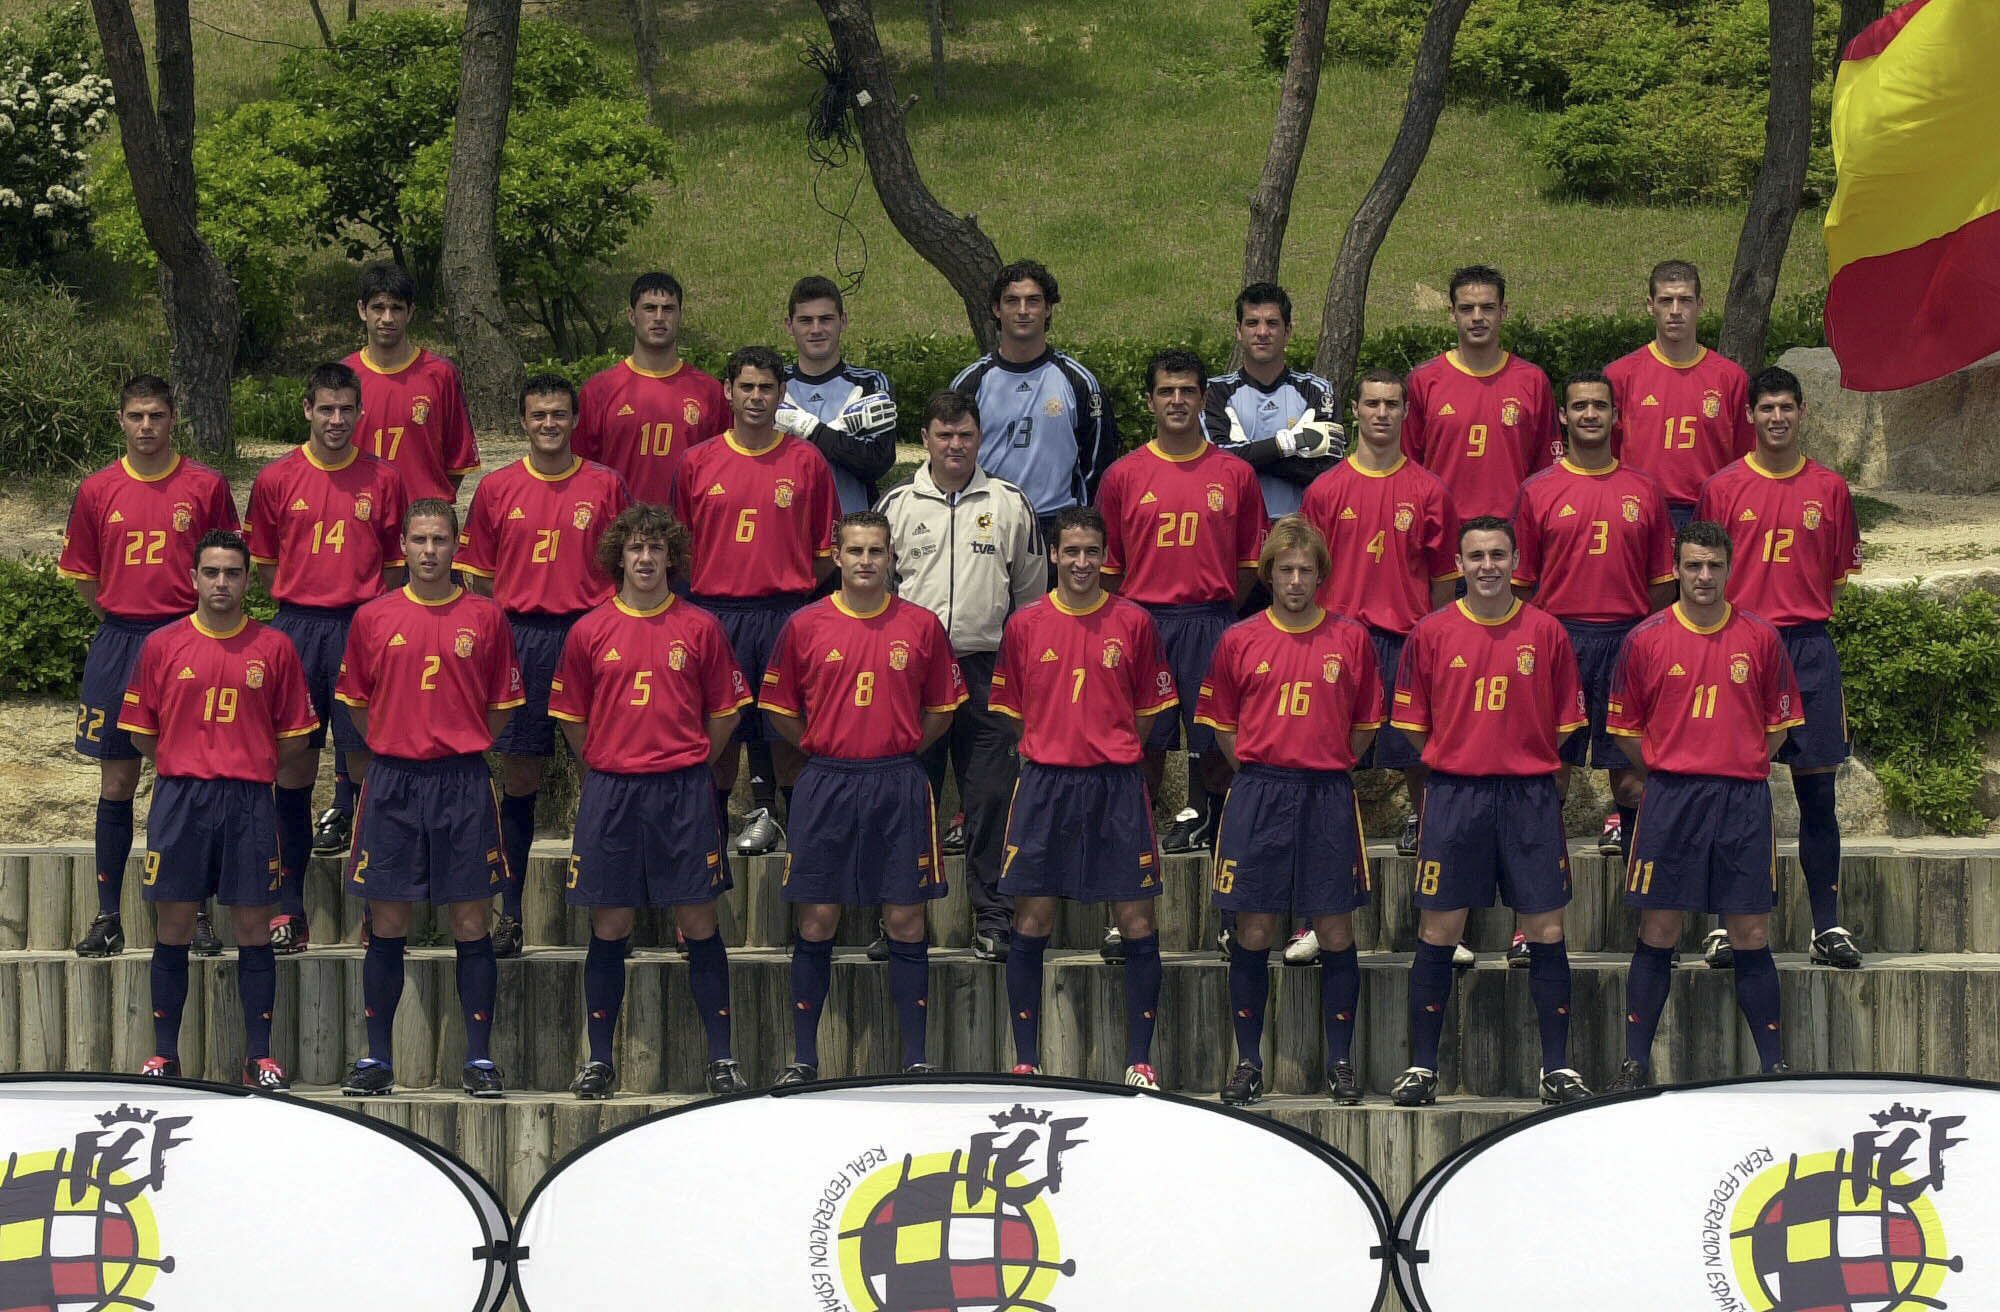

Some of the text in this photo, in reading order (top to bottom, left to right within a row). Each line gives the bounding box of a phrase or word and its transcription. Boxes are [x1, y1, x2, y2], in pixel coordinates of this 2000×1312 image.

[373, 426, 405, 461] 17
[640, 422, 674, 457] 10
[1006, 416, 1033, 449] 13
[1466, 424, 1487, 458] 9
[1664, 415, 1697, 450] 15
[311, 519, 347, 555] 14
[734, 508, 759, 544] 6
[1156, 511, 1200, 549] 20
[1589, 520, 1611, 556] 3
[124, 530, 168, 567] 22
[531, 529, 562, 564] 21
[971, 540, 997, 555] tve
[1366, 530, 1386, 564] 4
[1761, 528, 1796, 564] 12
[420, 655, 442, 691] 2
[629, 671, 654, 706] 5
[854, 671, 876, 708] 8
[1071, 667, 1086, 704] 7
[203, 687, 240, 724] 19
[1277, 681, 1314, 717] 16
[1473, 675, 1510, 713] 18
[1690, 685, 1719, 719] 11
[76, 704, 105, 743] 22
[352, 850, 369, 884] 2
[566, 854, 581, 889] 5
[1001, 845, 1020, 879] 7
[1415, 858, 1441, 896] 18
[1630, 858, 1654, 895] 11
[846, 1144, 888, 1177] REAL
[1734, 1145, 1773, 1177] REAL
[808, 1171, 852, 1268] FEDERACION
[1703, 1171, 1740, 1267] FEDERACION
